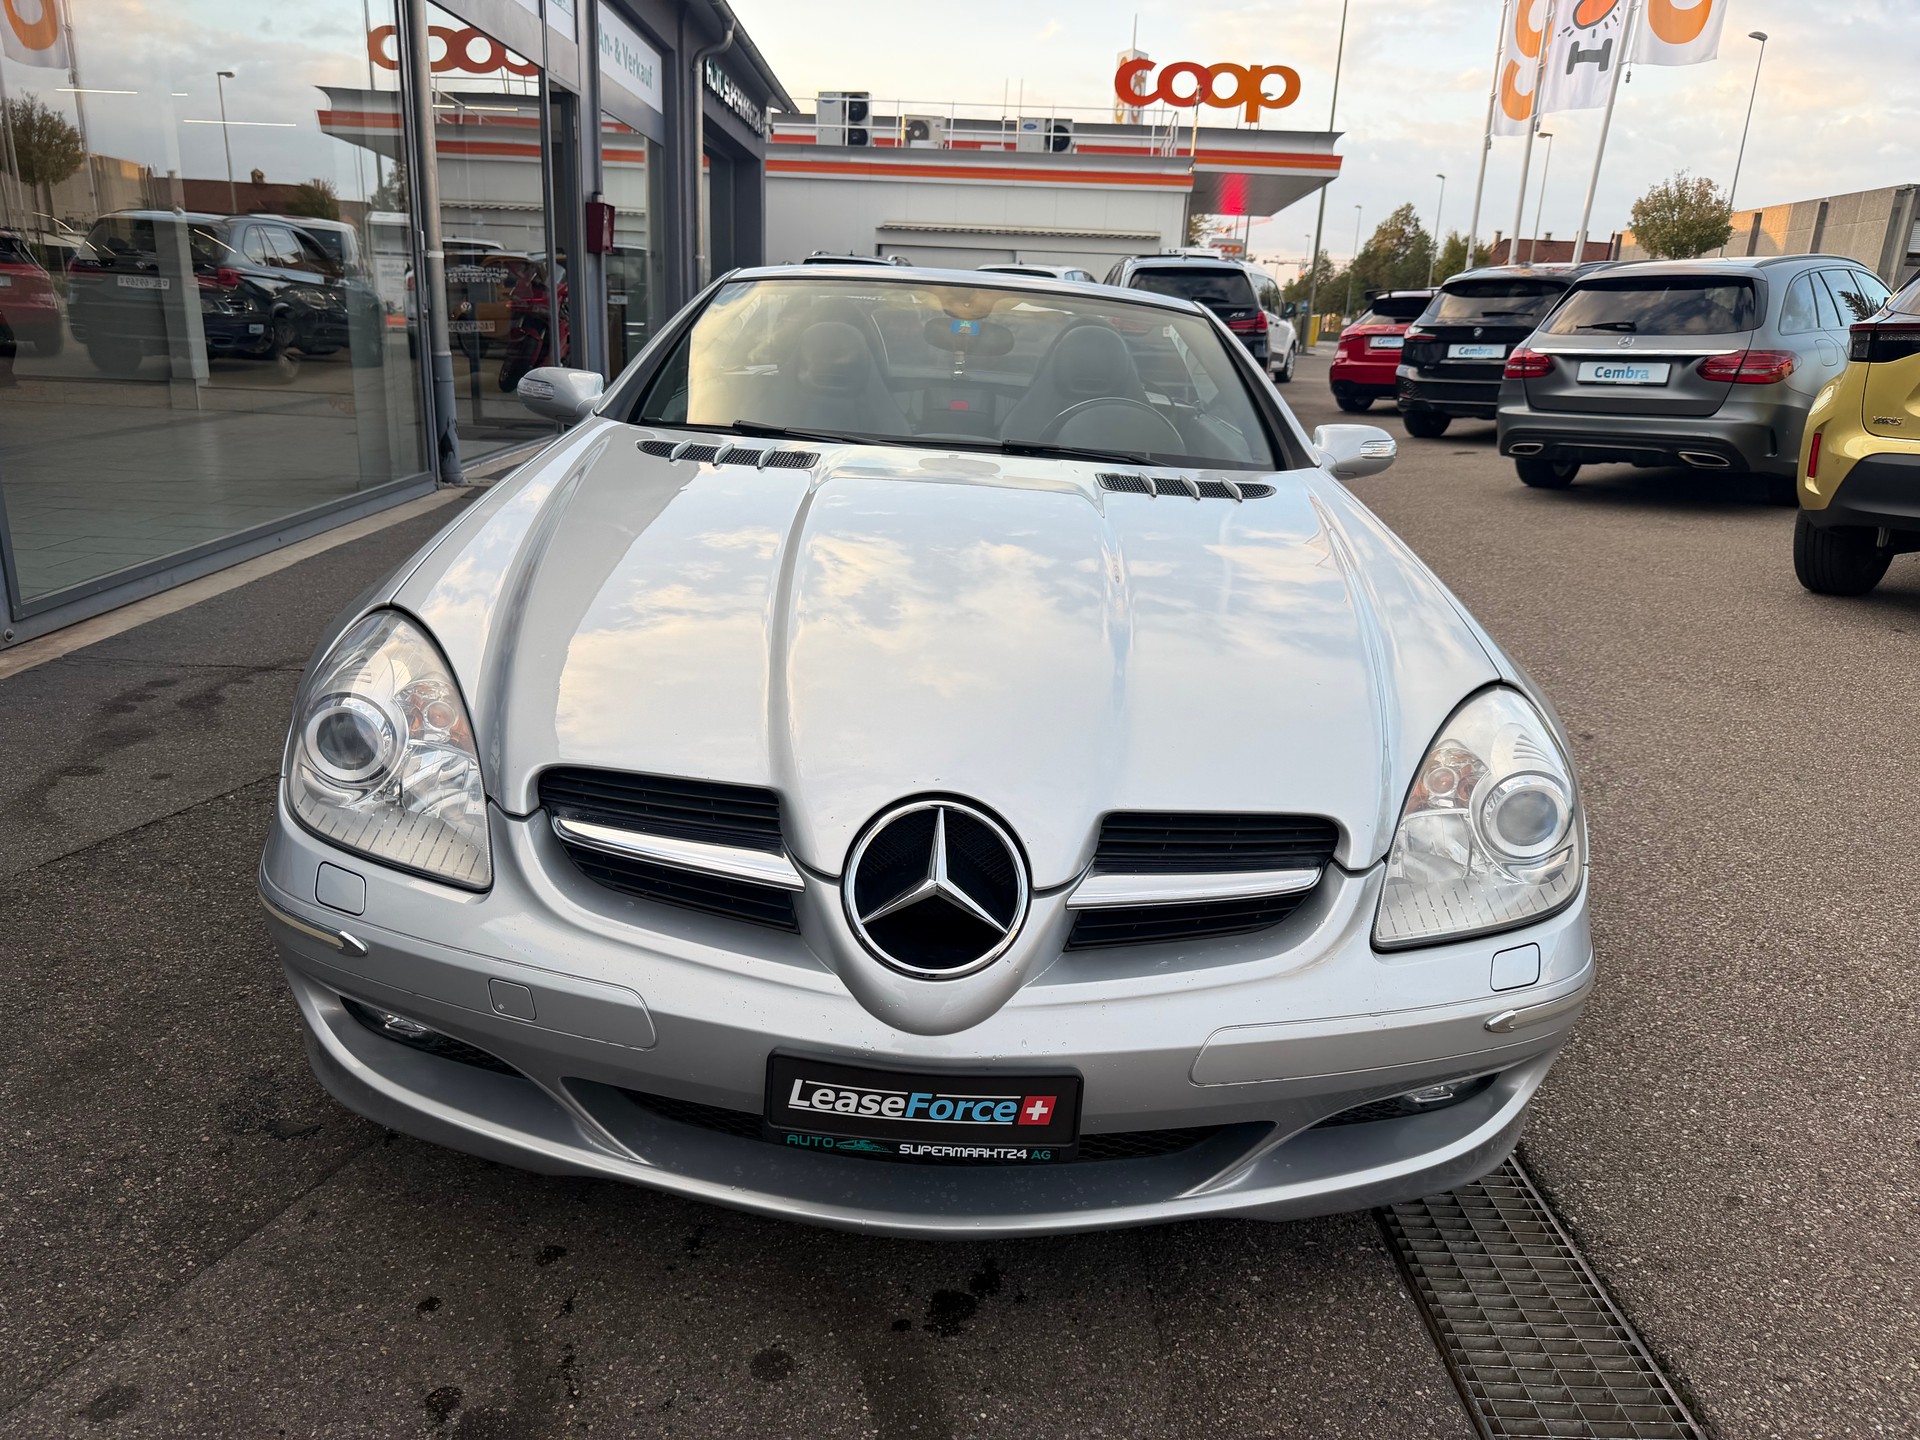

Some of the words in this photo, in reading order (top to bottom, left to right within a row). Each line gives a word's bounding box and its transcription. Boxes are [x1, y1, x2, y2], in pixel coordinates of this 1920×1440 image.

[614, 35, 622, 66] &
[622, 42, 653, 90] Verkauf
[1114, 58, 1302, 123] coop
[1458, 345, 1494, 356] Cembra
[1594, 365, 1650, 381] Cembra
[789, 1079, 1018, 1122] LeaseForce
[786, 1134, 835, 1149] AUTO
[899, 1143, 1028, 1160] SUPERMARKT24
[1030, 1149, 1052, 1160] AG
